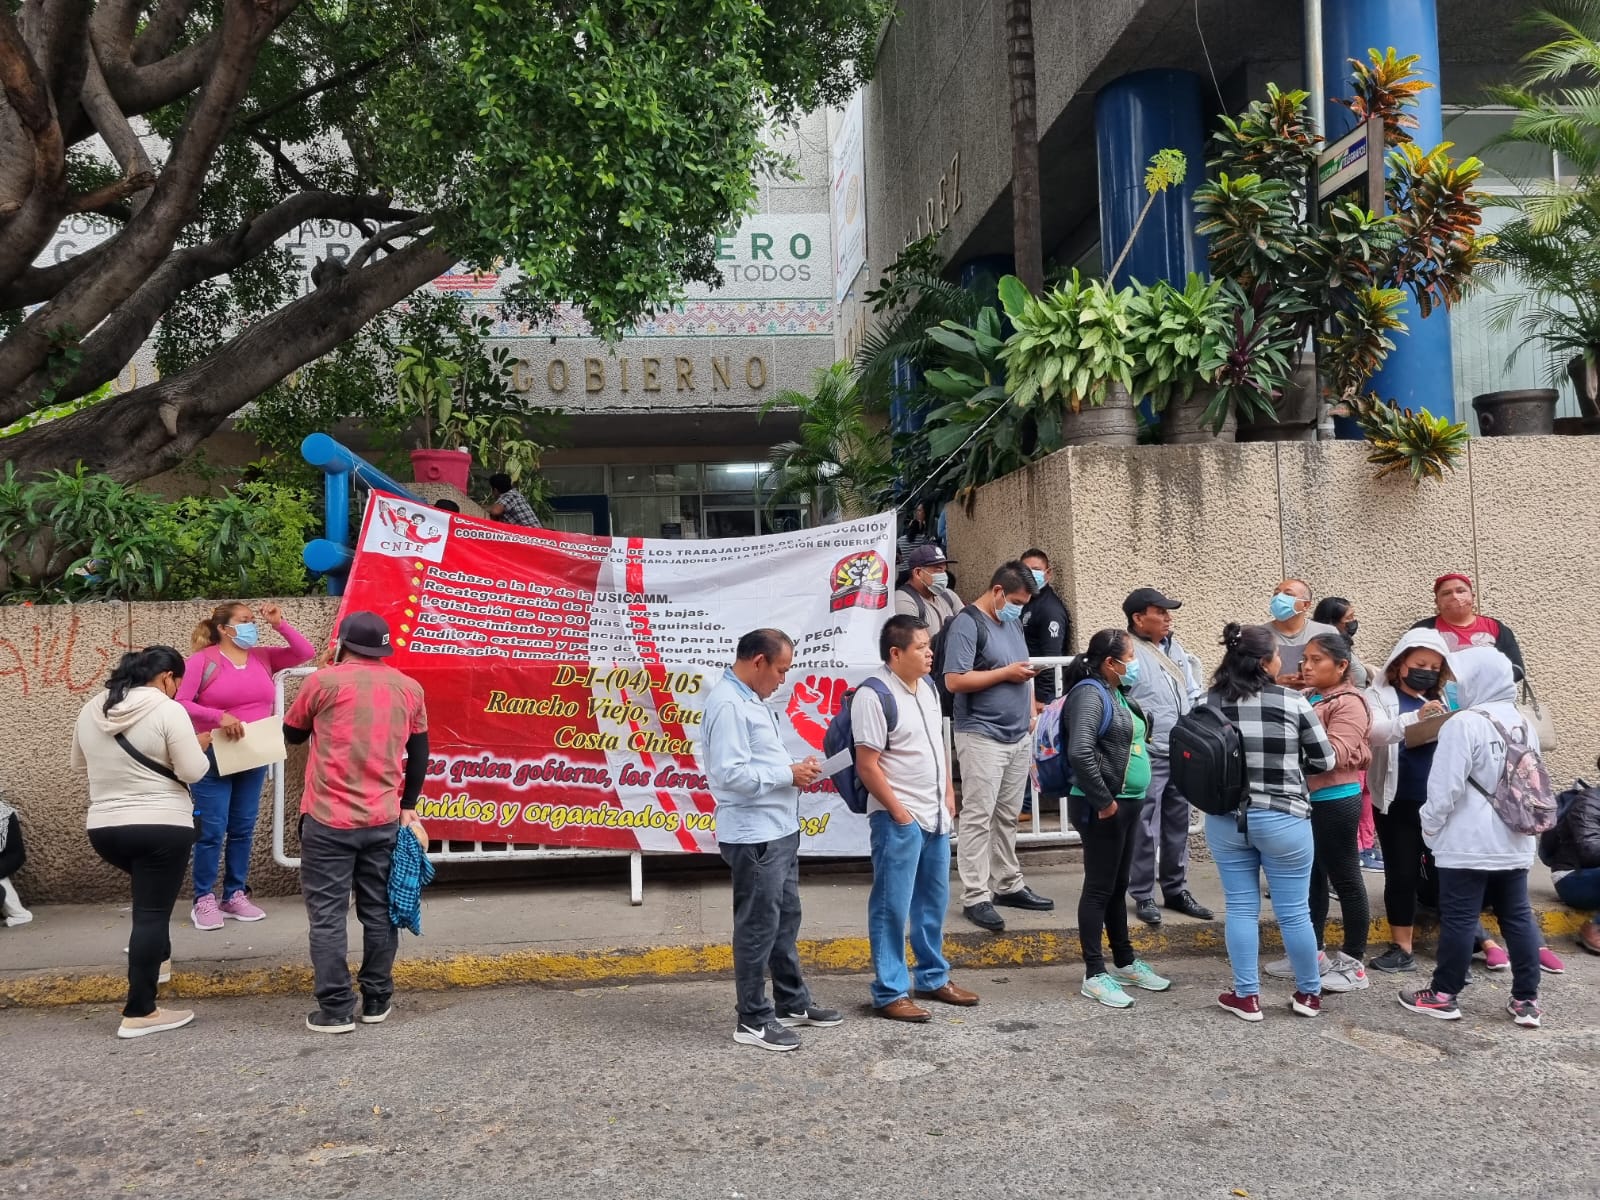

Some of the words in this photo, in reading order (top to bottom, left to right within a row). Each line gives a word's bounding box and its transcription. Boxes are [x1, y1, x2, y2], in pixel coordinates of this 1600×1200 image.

[715, 233, 812, 261] ERO
[729, 264, 812, 282] TODOS
[513, 355, 768, 393] GOBIERNO
[380, 541, 424, 554] CNTE
[560, 541, 624, 556] NACIONAL
[629, 548, 644, 557] DE
[649, 549, 673, 557] LOS
[677, 542, 776, 557] TRABAJADORES
[779, 538, 795, 547] DE
[610, 557, 631, 565] LOS
[634, 556, 719, 565] TRABAJADORES
[817, 539, 831, 548] EN
[834, 533, 889, 548] GUERRERO
[424, 580, 559, 610] Recategorización
[562, 602, 582, 613] de
[585, 603, 609, 614] las
[613, 607, 660, 619] claves
[665, 608, 710, 619] bajas.
[428, 566, 493, 586] Rechazo
[497, 580, 506, 589] a
[511, 581, 525, 591] la
[529, 583, 552, 596] ley
[556, 588, 574, 599] de
[578, 590, 593, 601] la
[597, 592, 673, 604] USICAMM.
[418, 613, 545, 635] Reconocimiento
[547, 626, 558, 637] y
[562, 627, 677, 643] financiamiento
[680, 635, 715, 646] para
[719, 634, 733, 645] la
[805, 626, 848, 643] PEGA.
[422, 595, 516, 618] Legislación
[516, 609, 535, 620] de
[538, 611, 562, 622] los
[566, 614, 586, 626] 90
[589, 616, 621, 628] días
[626, 619, 648, 630] de
[649, 621, 727, 632] aguinaldo.
[410, 641, 508, 658] Basificación
[513, 649, 592, 662] inmediata
[612, 655, 654, 664] todos
[660, 656, 683, 665] los
[688, 656, 733, 669] docen
[790, 656, 849, 669] ontrato.
[491, 636, 552, 648] externa
[556, 640, 567, 650] y
[570, 642, 610, 653] pago
[706, 645, 736, 655] hist
[803, 643, 836, 657] PPS.
[553, 664, 703, 696] D-I-(04)-105
[485, 690, 579, 718] Rancho
[586, 697, 650, 725] Viejo,
[658, 701, 702, 725] Gue
[553, 725, 619, 751] Costa
[627, 731, 694, 755] Chica
[451, 756, 512, 782] quien
[514, 758, 613, 788] gobierne,
[619, 763, 650, 786] los
[654, 767, 711, 790] derec
[500, 802, 519, 826] y
[523, 802, 679, 831] organizados
